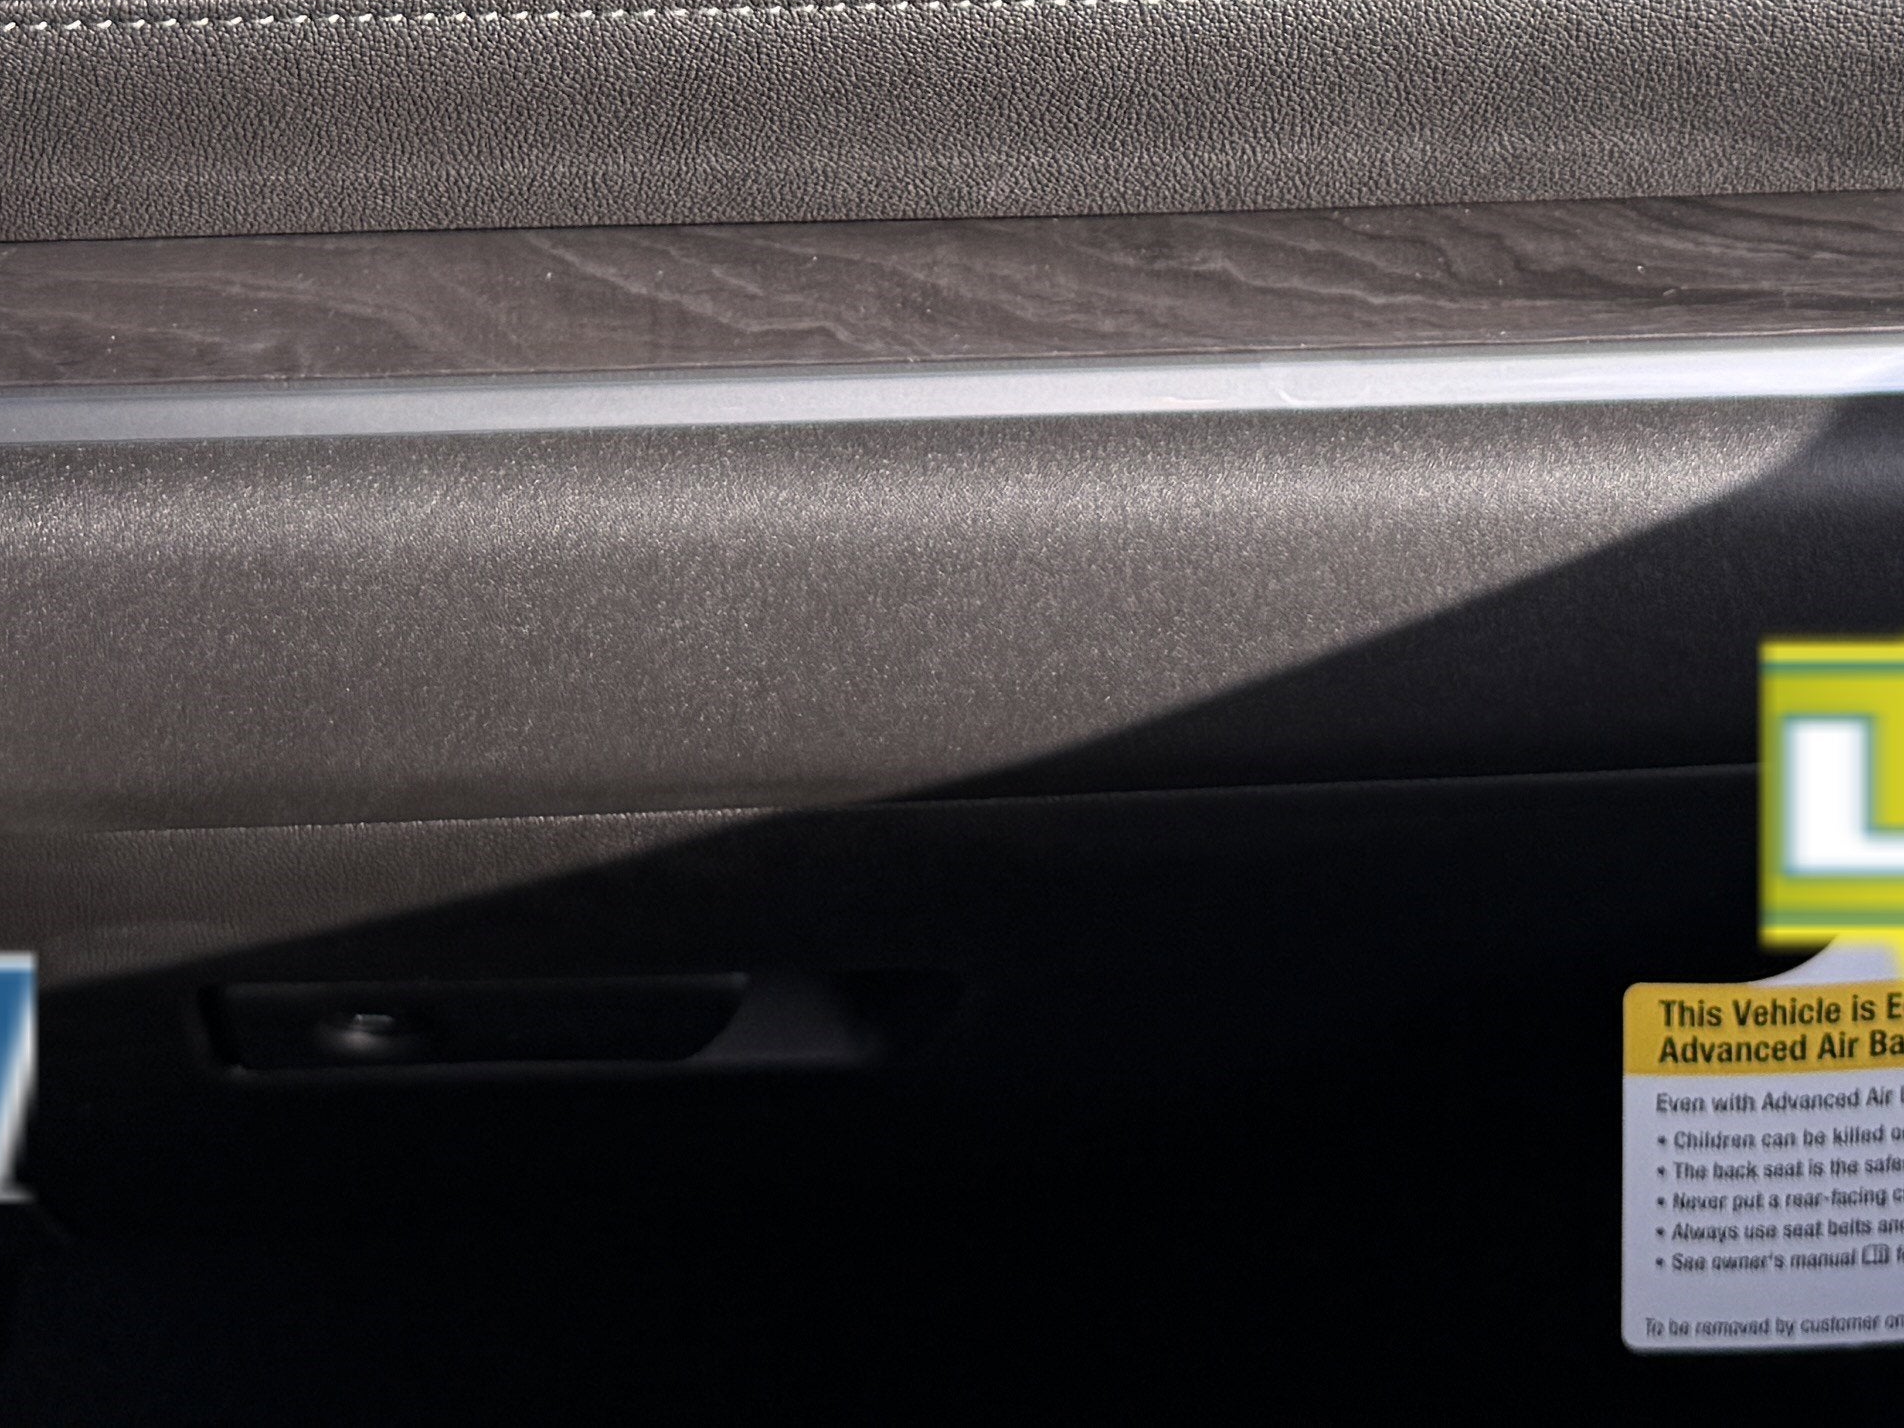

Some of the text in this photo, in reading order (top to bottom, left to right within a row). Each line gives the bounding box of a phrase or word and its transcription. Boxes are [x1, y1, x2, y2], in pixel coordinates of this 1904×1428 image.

[1658, 998, 1723, 1029] This
[1732, 994, 1841, 1027] Vehicle
[1851, 994, 1876, 1023] is
[1658, 1033, 1807, 1064] Advanced
[1818, 1030, 1860, 1060] Air
[1656, 1092, 1705, 1114] Even
[1712, 1091, 1756, 1112] with
[1761, 1088, 1860, 1111] Advanced
[1866, 1086, 1893, 1107] Air
[1673, 1130, 1756, 1149] Children
[1761, 1132, 1797, 1148] can
[1803, 1128, 1827, 1146] be
[1833, 1124, 1885, 1146] killed
[1673, 1161, 1708, 1180] The
[1713, 1160, 1759, 1179] back
[1763, 1160, 1805, 1178] seat
[1808, 1158, 1825, 1176] is
[1830, 1157, 1859, 1176] the
[1672, 1192, 1726, 1211] Never
[1732, 1191, 1764, 1213] put
[1768, 1195, 1780, 1209] a
[1785, 1187, 1888, 1209] rear-facing
[1672, 1221, 1739, 1243] Always
[1744, 1223, 1778, 1240] use
[1783, 1220, 1823, 1239] seat
[1828, 1217, 1873, 1236] belts
[1672, 1252, 1707, 1271] See
[1711, 1251, 1785, 1270] owner's
[1790, 1248, 1857, 1268] manual
[1646, 1316, 1664, 1337] To
[1669, 1317, 1689, 1336] be
[1695, 1316, 1770, 1337] removed
[1775, 1315, 1795, 1338] by
[1800, 1313, 1881, 1333] customer
